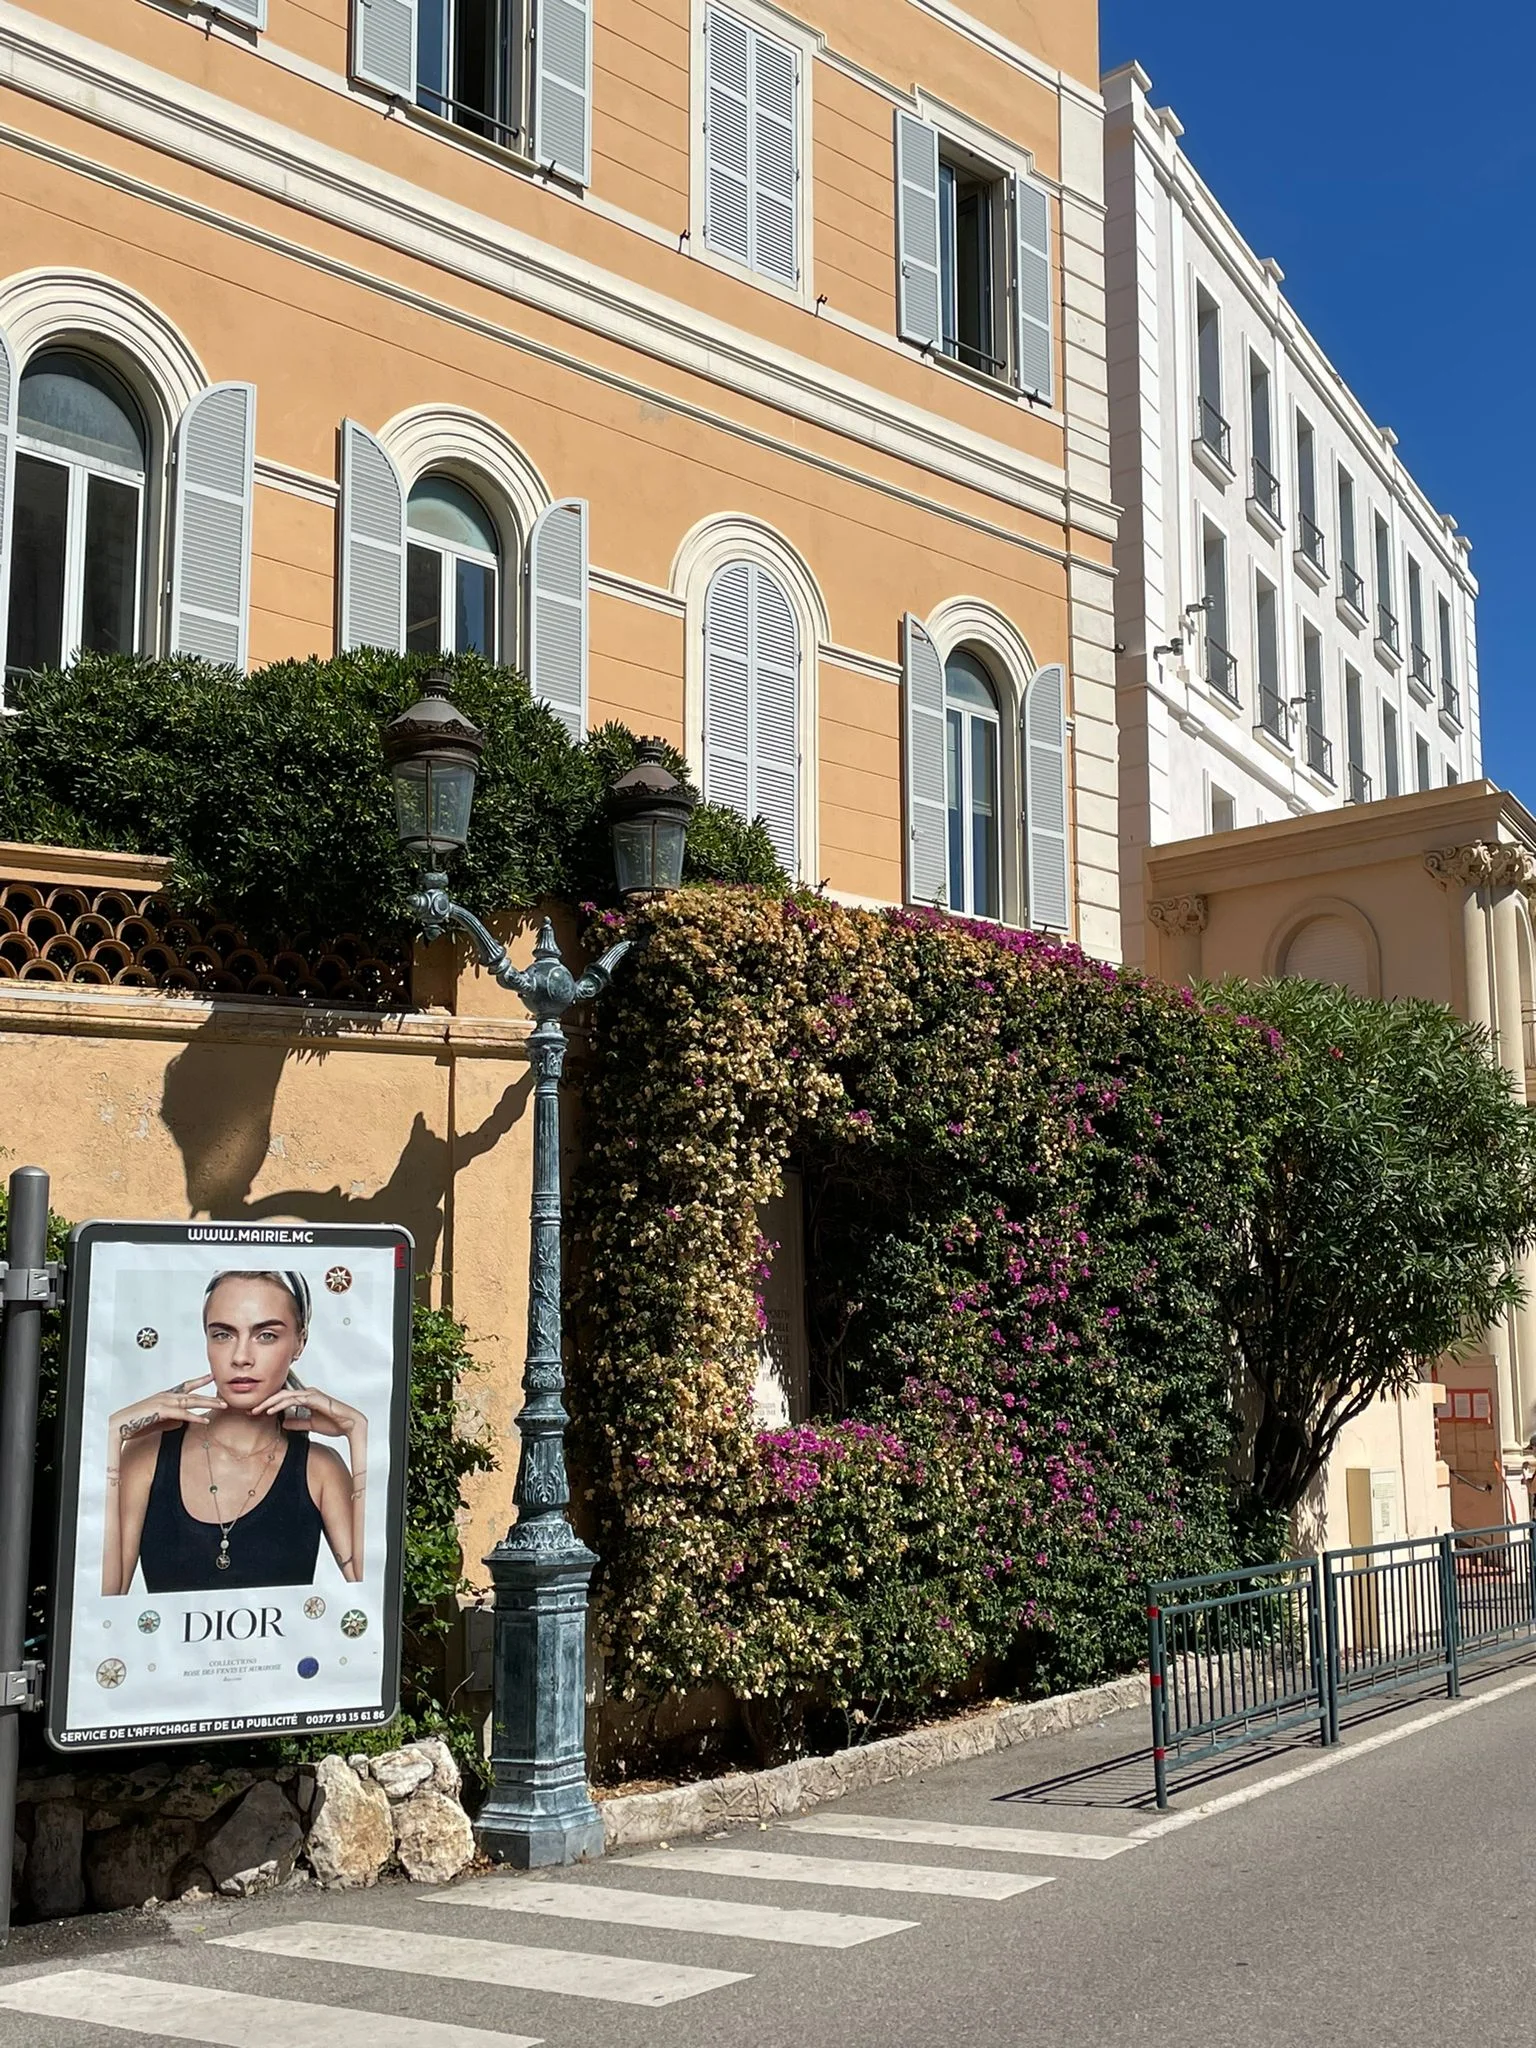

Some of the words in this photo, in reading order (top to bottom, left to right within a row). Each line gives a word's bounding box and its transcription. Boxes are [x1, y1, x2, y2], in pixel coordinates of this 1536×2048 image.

[188, 1228, 314, 1243] WWW.MAIRIE.MC
[181, 1607, 286, 1643] DIOR
[209, 1658, 257, 1667] COLLECTIONS
[60, 1730, 107, 1742] SERVICE
[110, 1729, 125, 1739] DE
[128, 1723, 197, 1737] L'AFFICHAGE
[199, 1721, 213, 1732] ET
[214, 1720, 229, 1731] DE
[231, 1719, 244, 1729] LA
[246, 1713, 298, 1728] PUBLICITÉ
[306, 1714, 333, 1725] 00377
[335, 1713, 347, 1723] 93
[349, 1712, 359, 1722] 15
[361, 1711, 371, 1721] 61
[373, 1710, 385, 1720] 86
